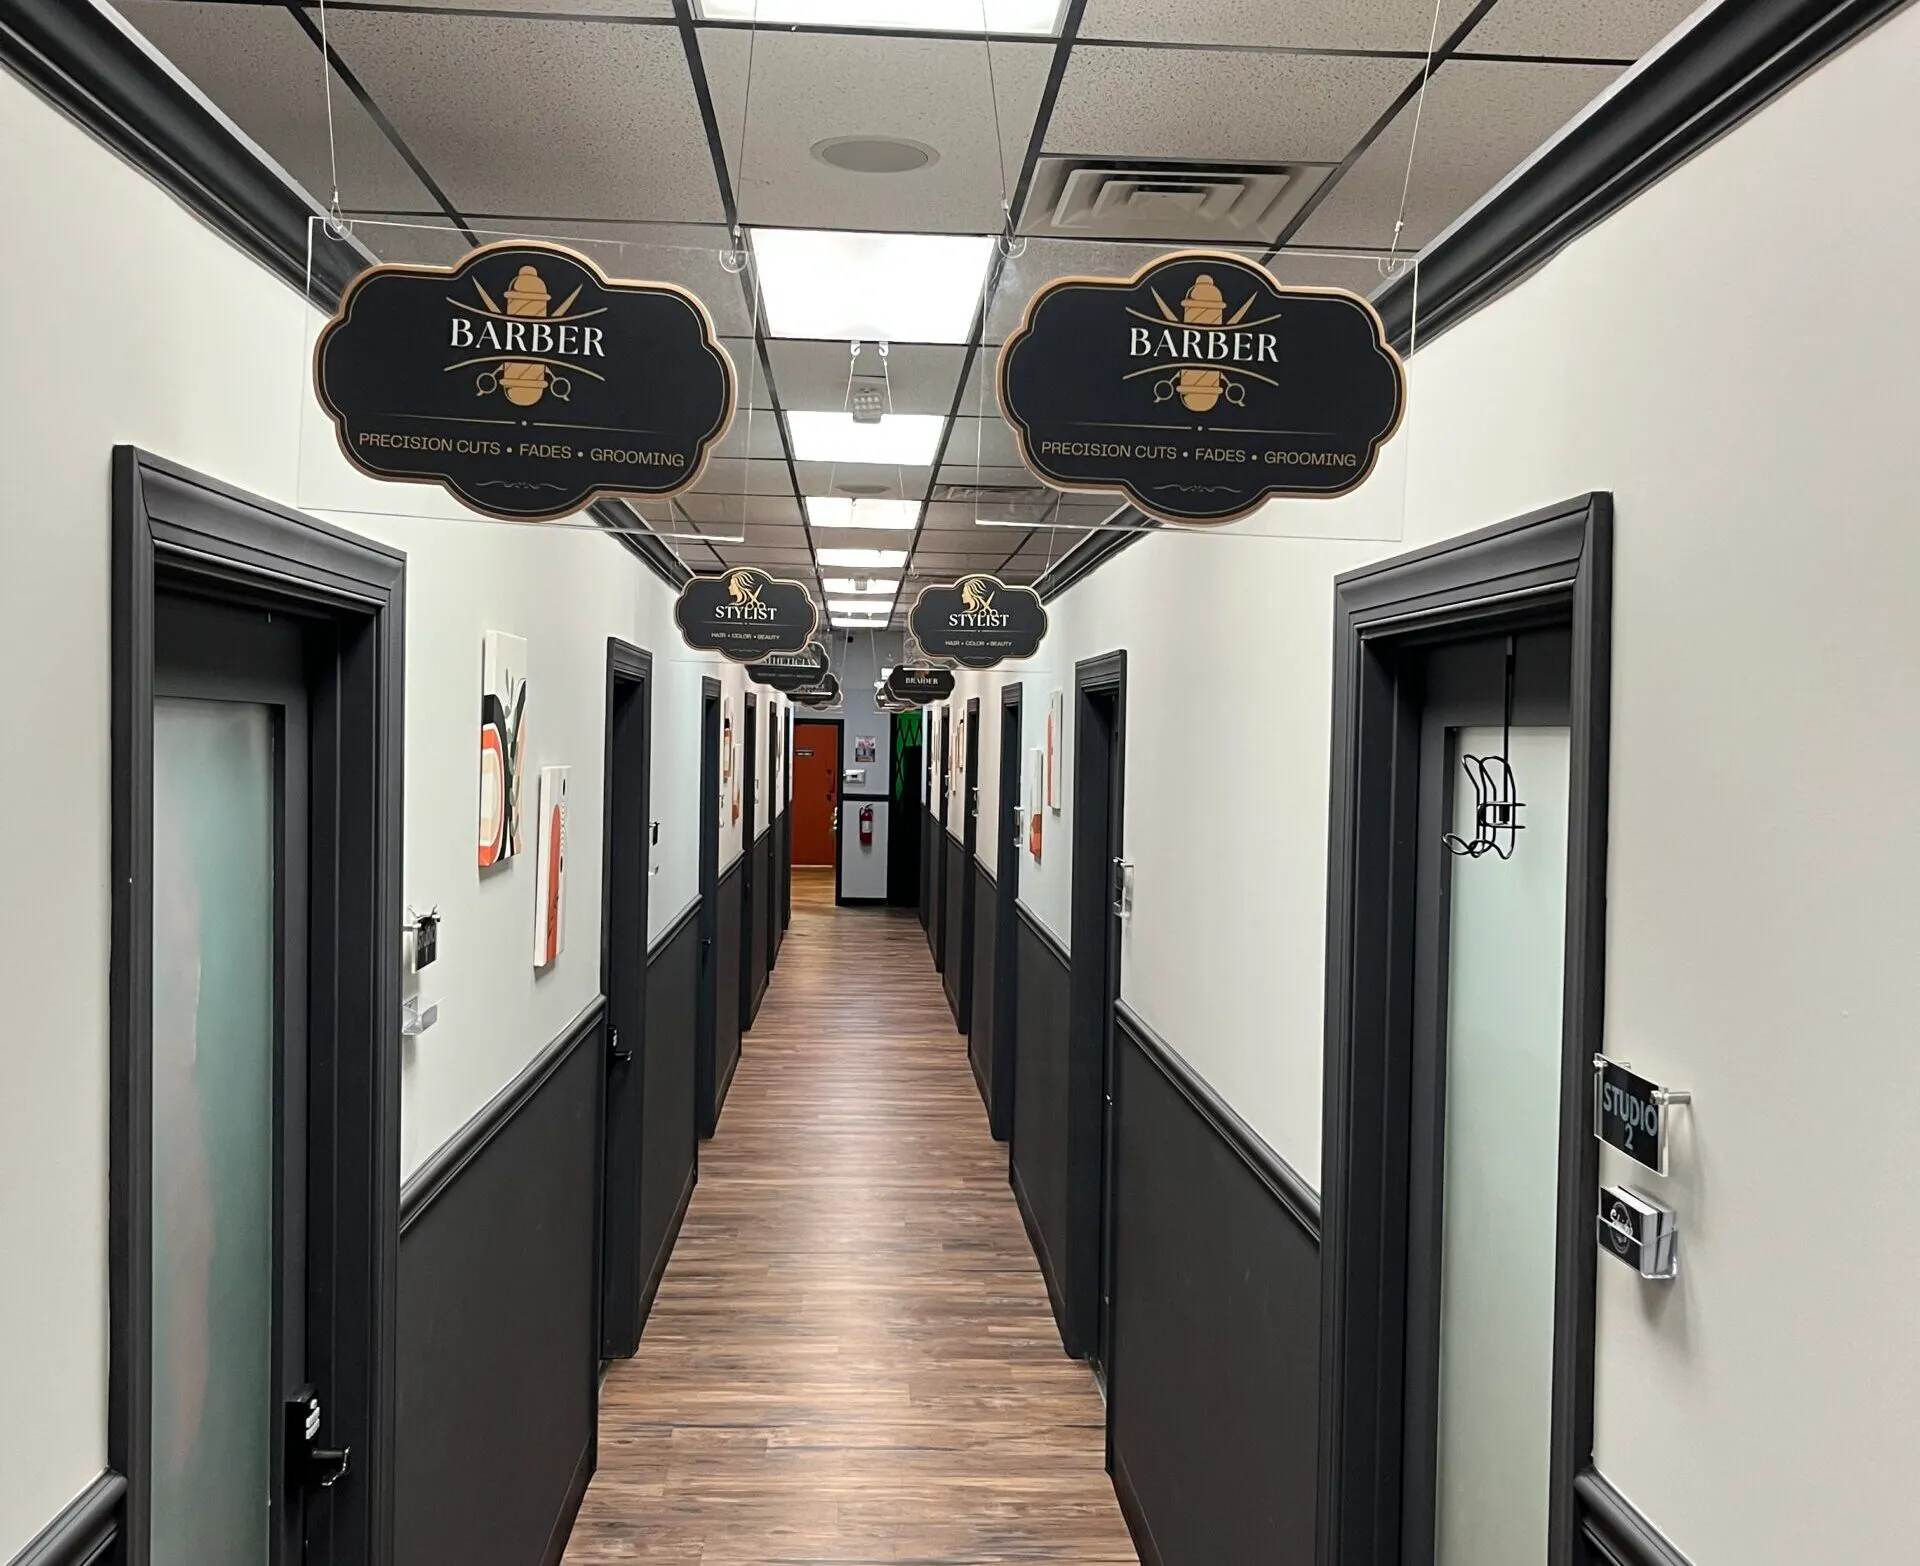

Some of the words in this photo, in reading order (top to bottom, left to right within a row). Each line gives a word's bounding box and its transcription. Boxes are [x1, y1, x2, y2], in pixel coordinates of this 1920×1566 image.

[449, 317, 606, 358] BARBER
[1129, 327, 1279, 362] BARBER
[359, 432, 453, 452] PRECISION
[456, 439, 501, 456] CUTS
[519, 443, 572, 460] FADES
[590, 448, 685, 467] GROOMING
[1041, 441, 1131, 459] PRECISION
[1134, 445, 1177, 460] CUTS
[1195, 448, 1246, 463] FADES
[1264, 451, 1357, 467] GROOMING
[715, 605, 777, 620] STYLIST
[948, 613, 1010, 627] STYLIST
[1603, 1082, 1658, 1136] STUDIO
[1624, 1123, 1634, 1150] 2
